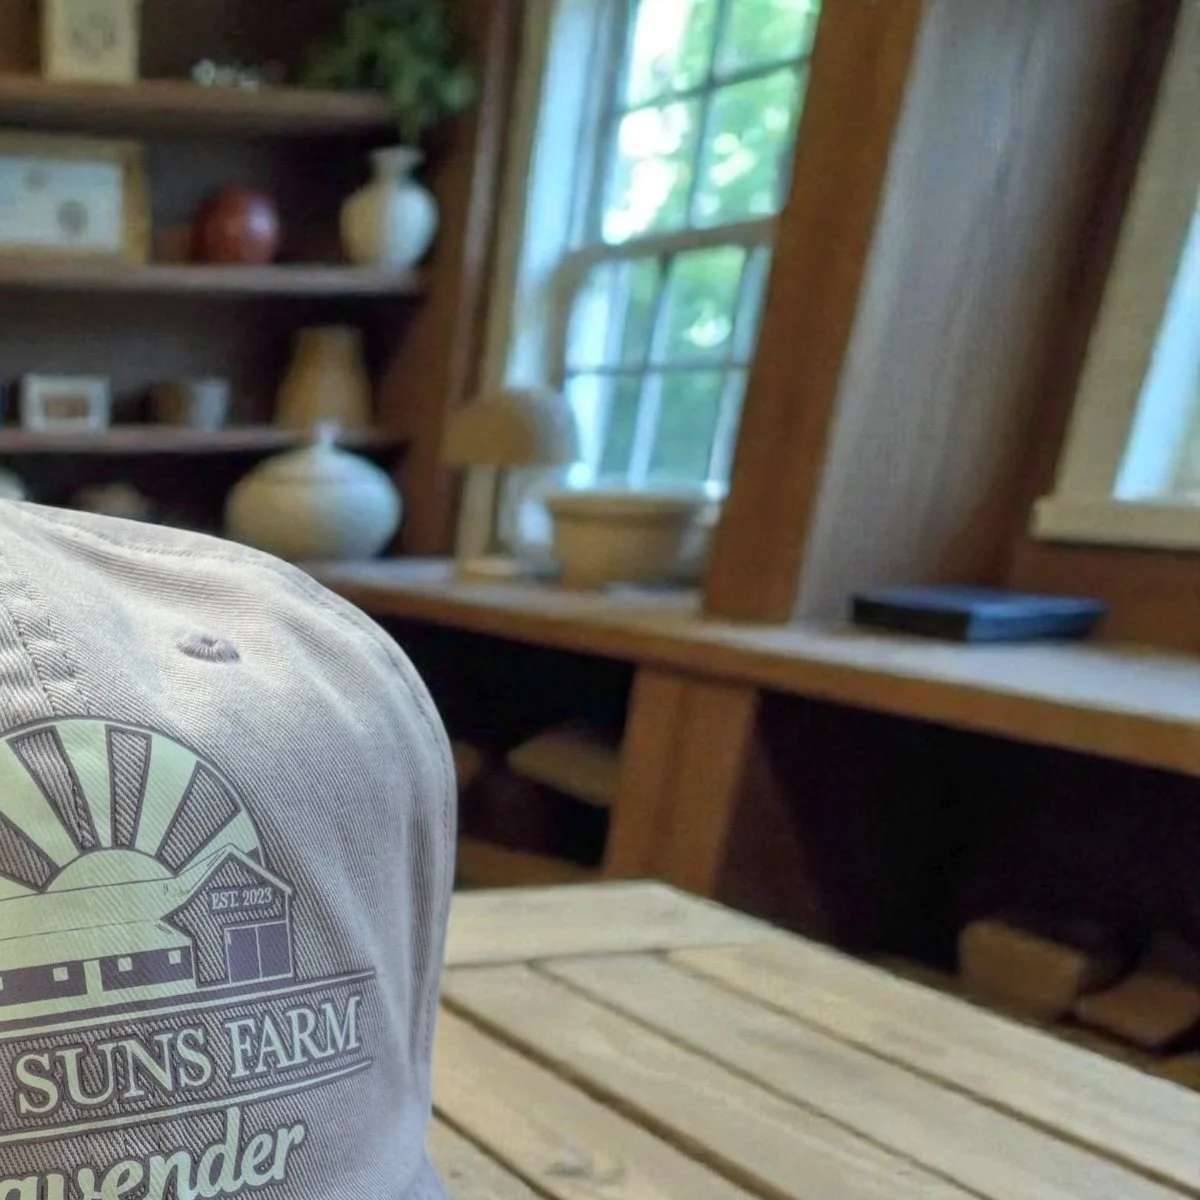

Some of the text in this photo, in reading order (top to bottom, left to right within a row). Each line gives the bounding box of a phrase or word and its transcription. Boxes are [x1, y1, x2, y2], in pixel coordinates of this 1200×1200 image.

[242, 887, 272, 906] 2023
[14, 1029, 211, 1114] SUNS
[226, 996, 361, 1078] FARM
